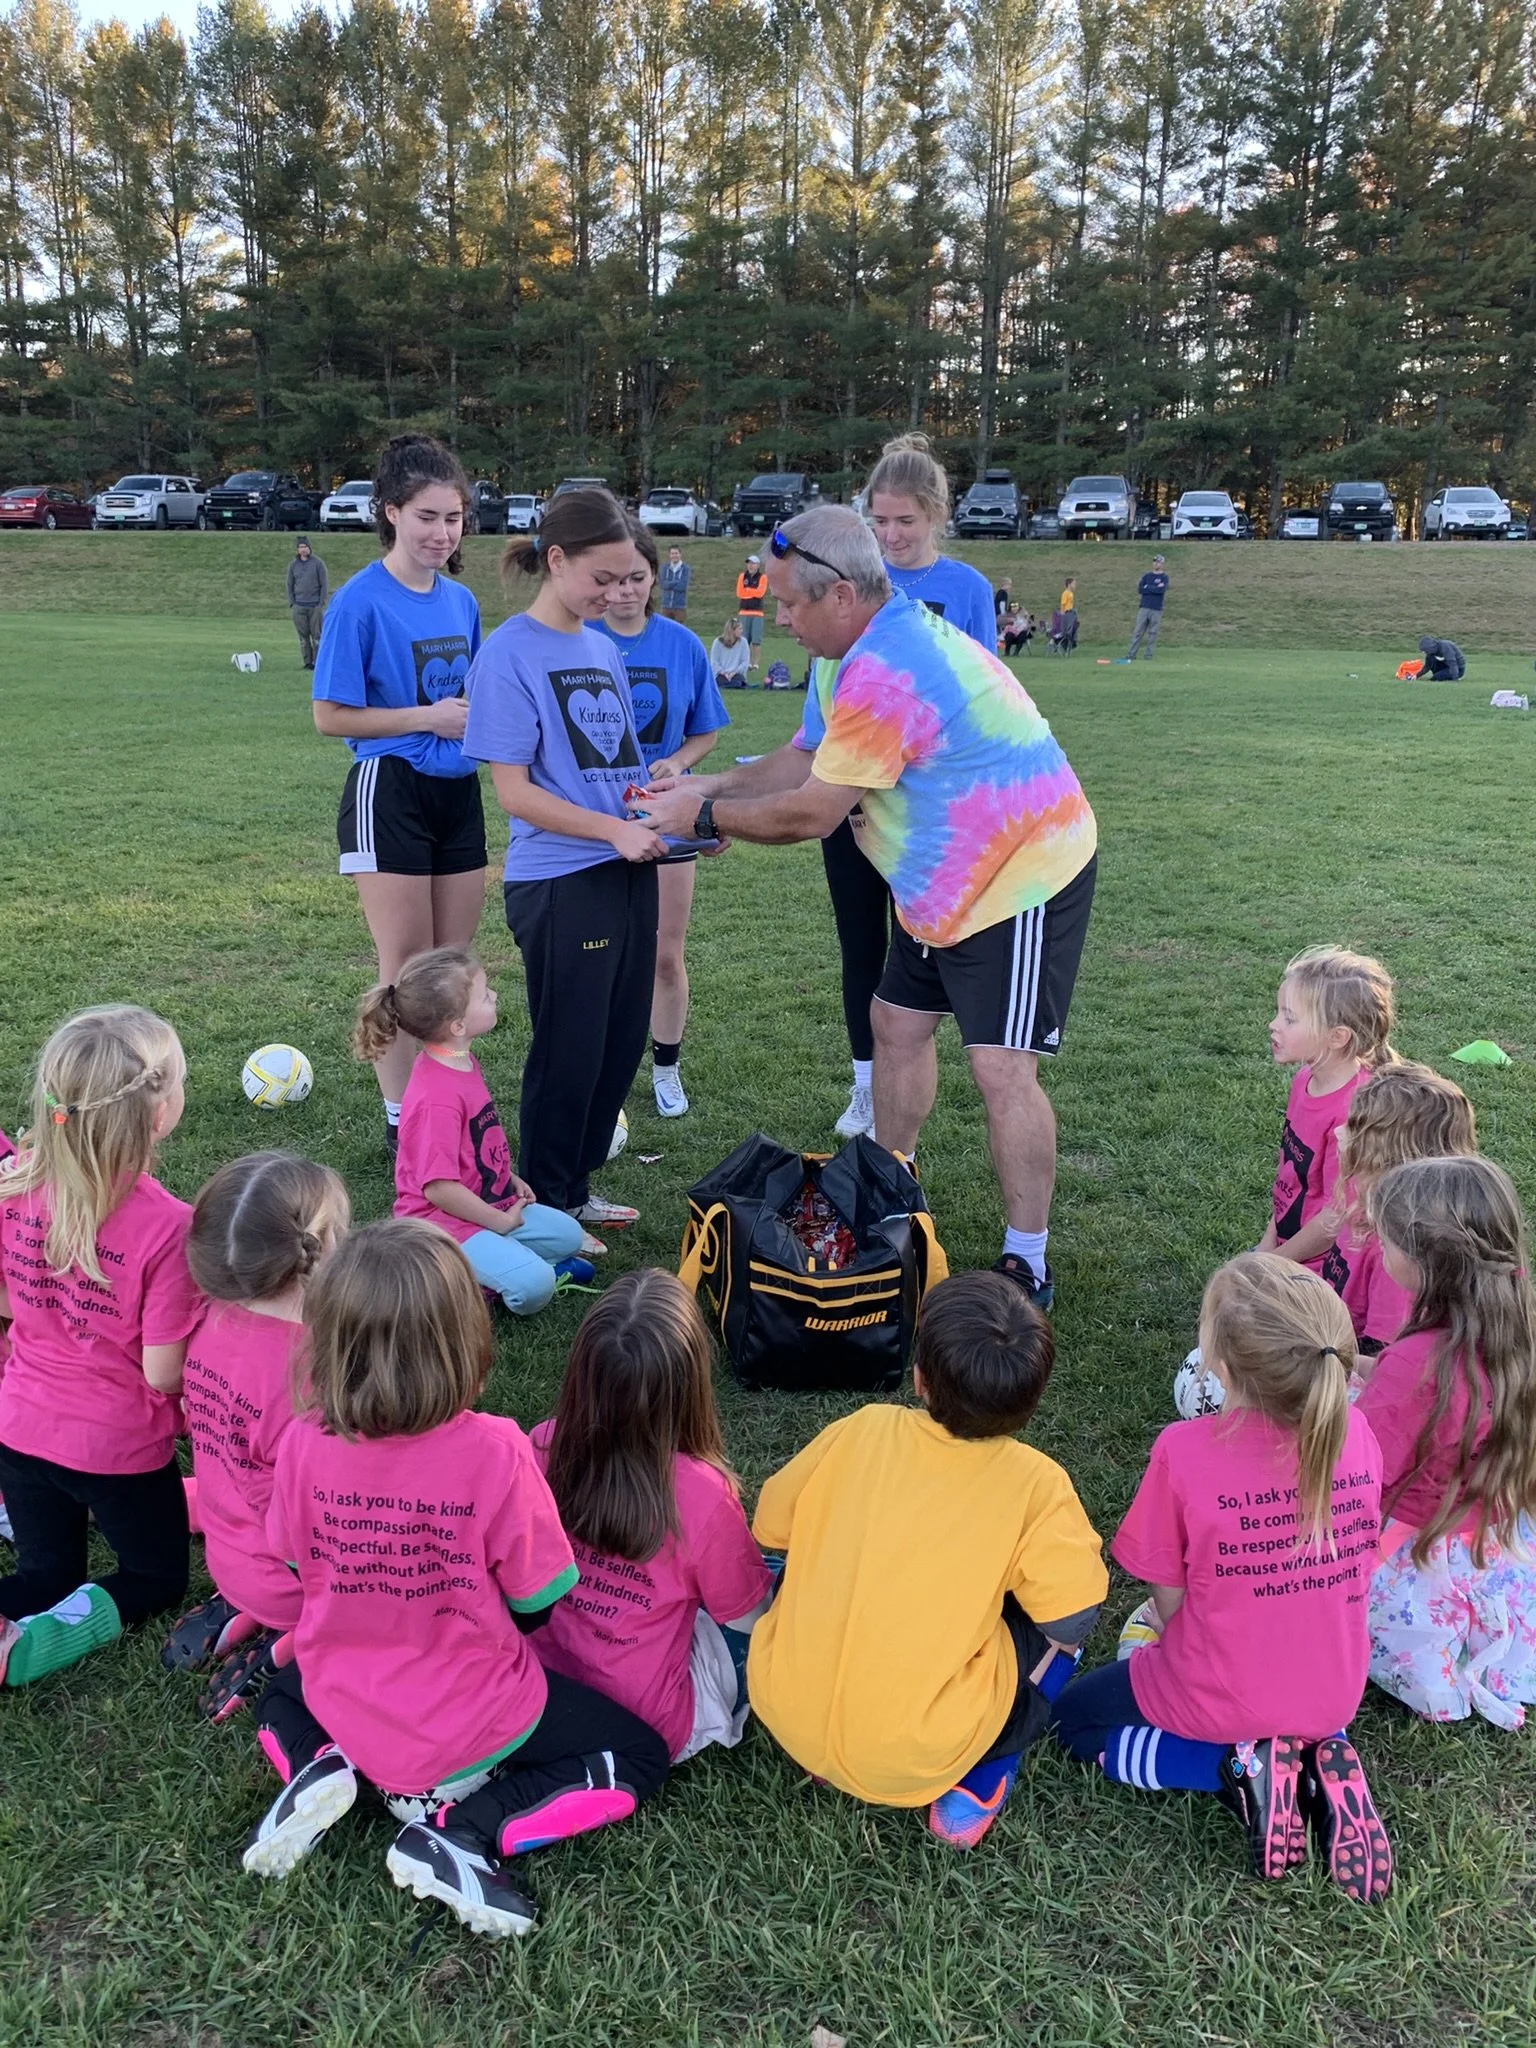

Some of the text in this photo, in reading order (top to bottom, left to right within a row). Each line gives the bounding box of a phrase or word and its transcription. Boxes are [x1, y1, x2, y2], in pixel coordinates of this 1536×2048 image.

[561, 675, 585, 686] MARY
[627, 671, 658, 679] HARRIS
[583, 938, 610, 950] LILLEY
[804, 1310, 888, 1332] WARRIOR
[186, 1357, 202, 1374] ask
[1217, 1494, 1243, 1511] So,
[1246, 1492, 1251, 1507] I
[1254, 1487, 1281, 1505] ask
[1348, 1470, 1374, 1488] kind.
[313, 1485, 477, 1519] So, I ask you to be kind.
[323, 1511, 457, 1541] Be compassionate.
[1240, 1515, 1261, 1531] Be
[401, 1543, 421, 1557] Be
[1218, 1541, 1239, 1556] Be
[353, 1561, 414, 1578] without
[588, 1550, 605, 1569] Be
[606, 1560, 656, 1589] selfless.
[1215, 1562, 1278, 1578] Because
[330, 1578, 451, 1601] what's the point?
[593, 1576, 652, 1612] kindness,
[1253, 1578, 1300, 1597] what's
[1303, 1575, 1326, 1591] the
[574, 1596, 618, 1619] point?
